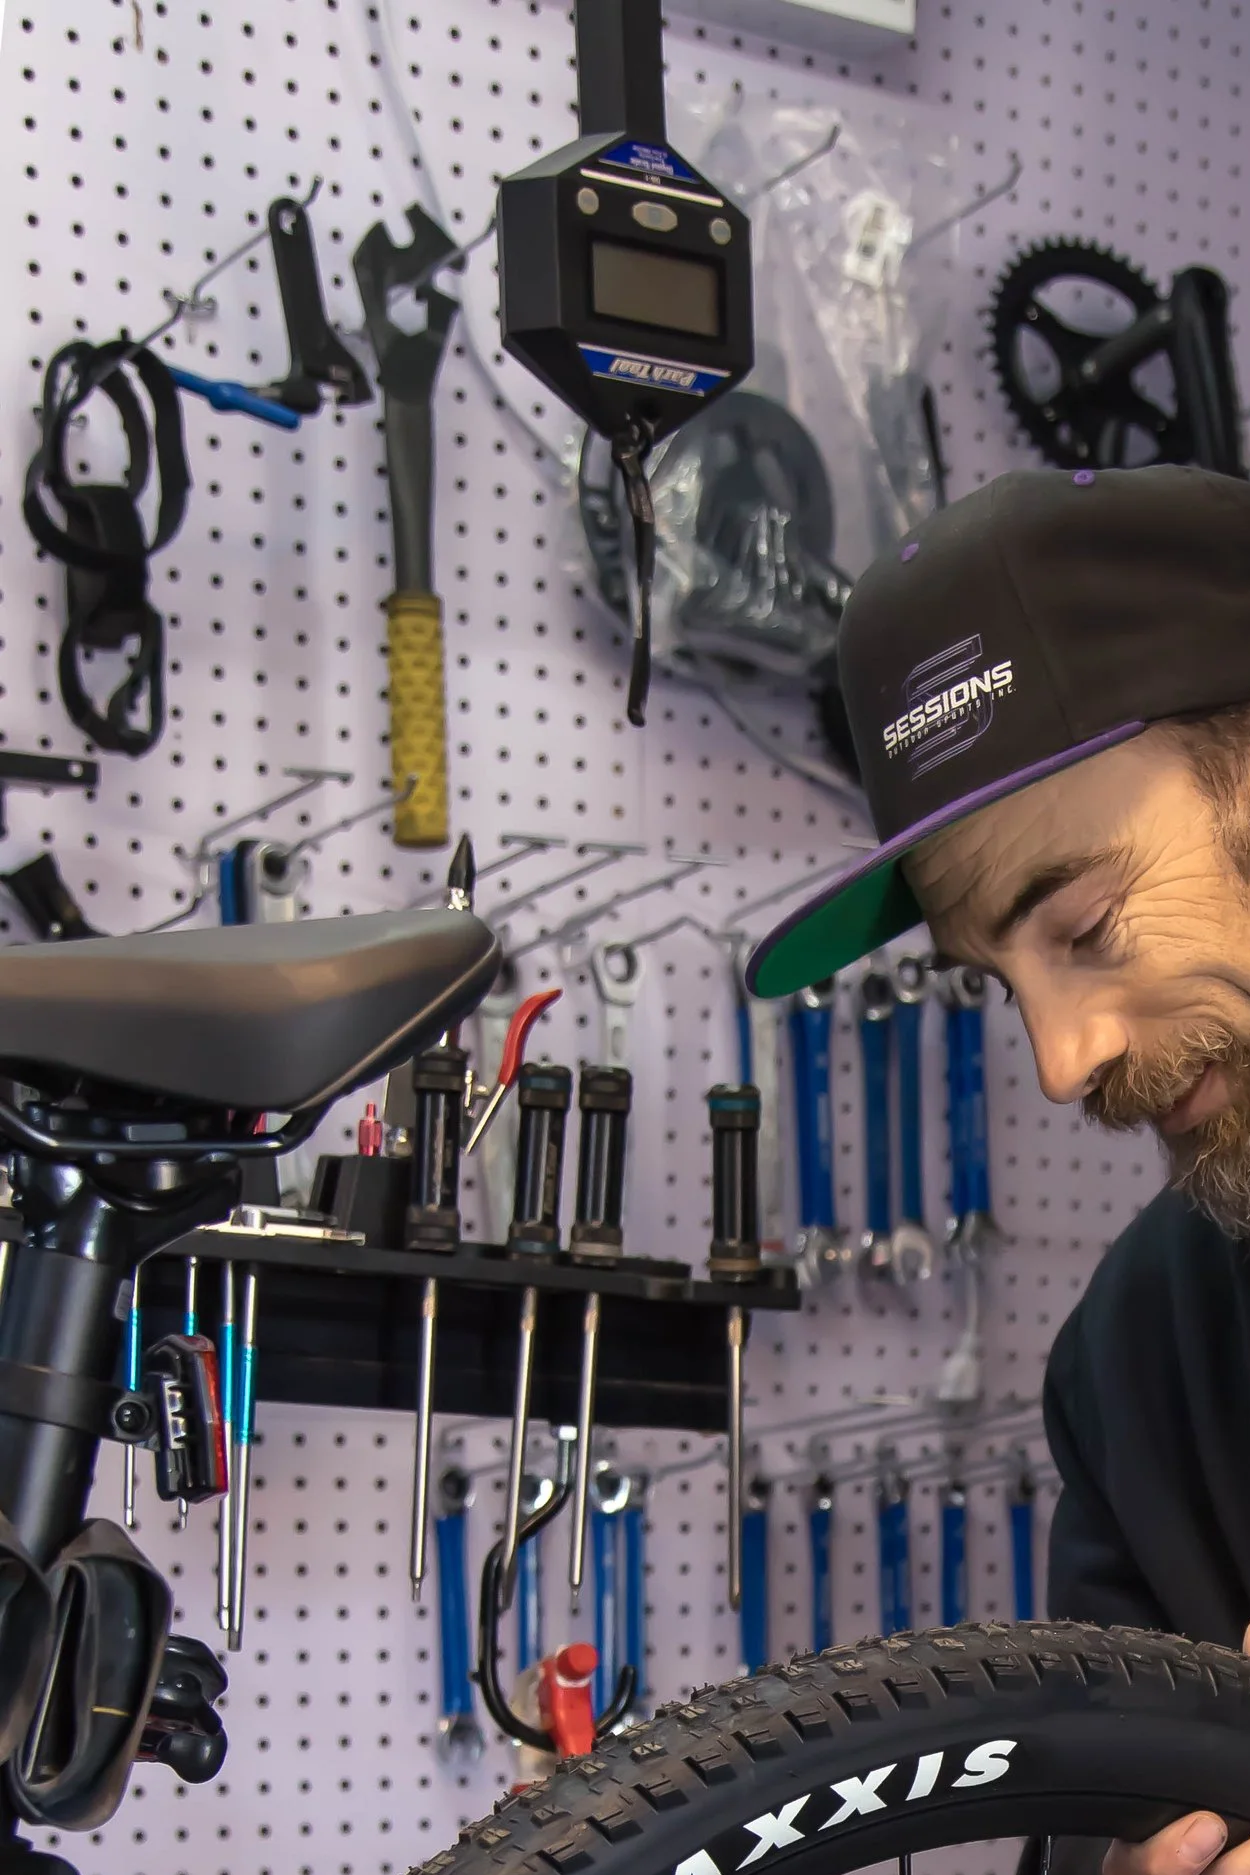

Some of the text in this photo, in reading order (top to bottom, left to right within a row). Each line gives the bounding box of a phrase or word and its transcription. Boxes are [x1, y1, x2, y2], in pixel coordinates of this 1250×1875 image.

[609, 358, 697, 389] Park Tool
[883, 660, 1013, 750] SESSIONS
[888, 685, 1017, 759] OUTDOOR SPORTS INC.
